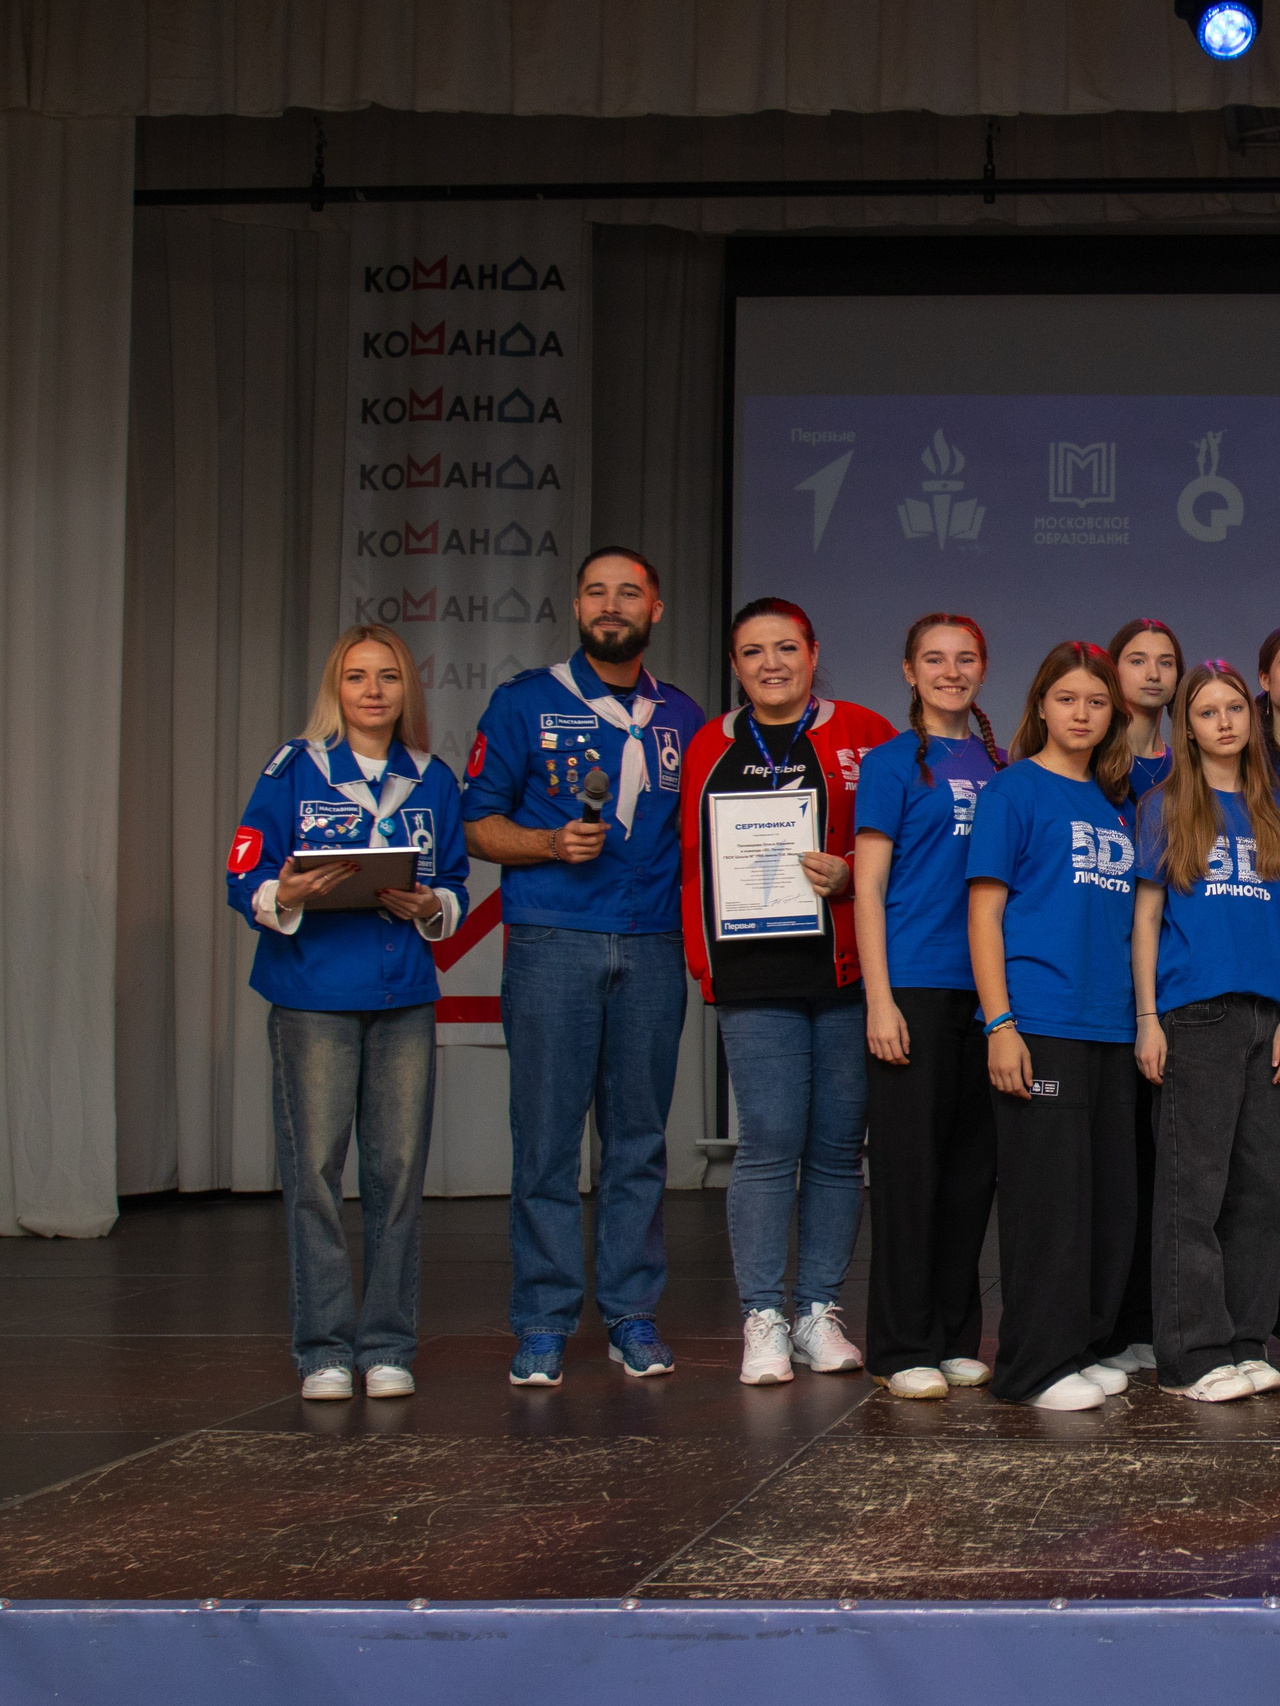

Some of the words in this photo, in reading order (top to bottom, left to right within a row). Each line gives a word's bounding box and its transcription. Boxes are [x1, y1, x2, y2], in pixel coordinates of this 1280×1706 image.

[364, 255, 566, 293] КОМАНДА
[363, 320, 564, 358] КОМАНДА
[361, 386, 563, 424] КОМАНДА
[790, 428, 855, 448] Первые
[360, 452, 561, 491] КОМАНДА
[1034, 516, 1130, 530] МОСКОВСКОЕ
[358, 519, 560, 557] КОМАНДА
[1034, 532, 1130, 545] ОБРАЗОВАНИЕ
[735, 821, 796, 831] СЕРТИФИКАТ
[1205, 883, 1272, 901] ЛИЧНОСТЬ
[724, 922, 756, 932] Первые
